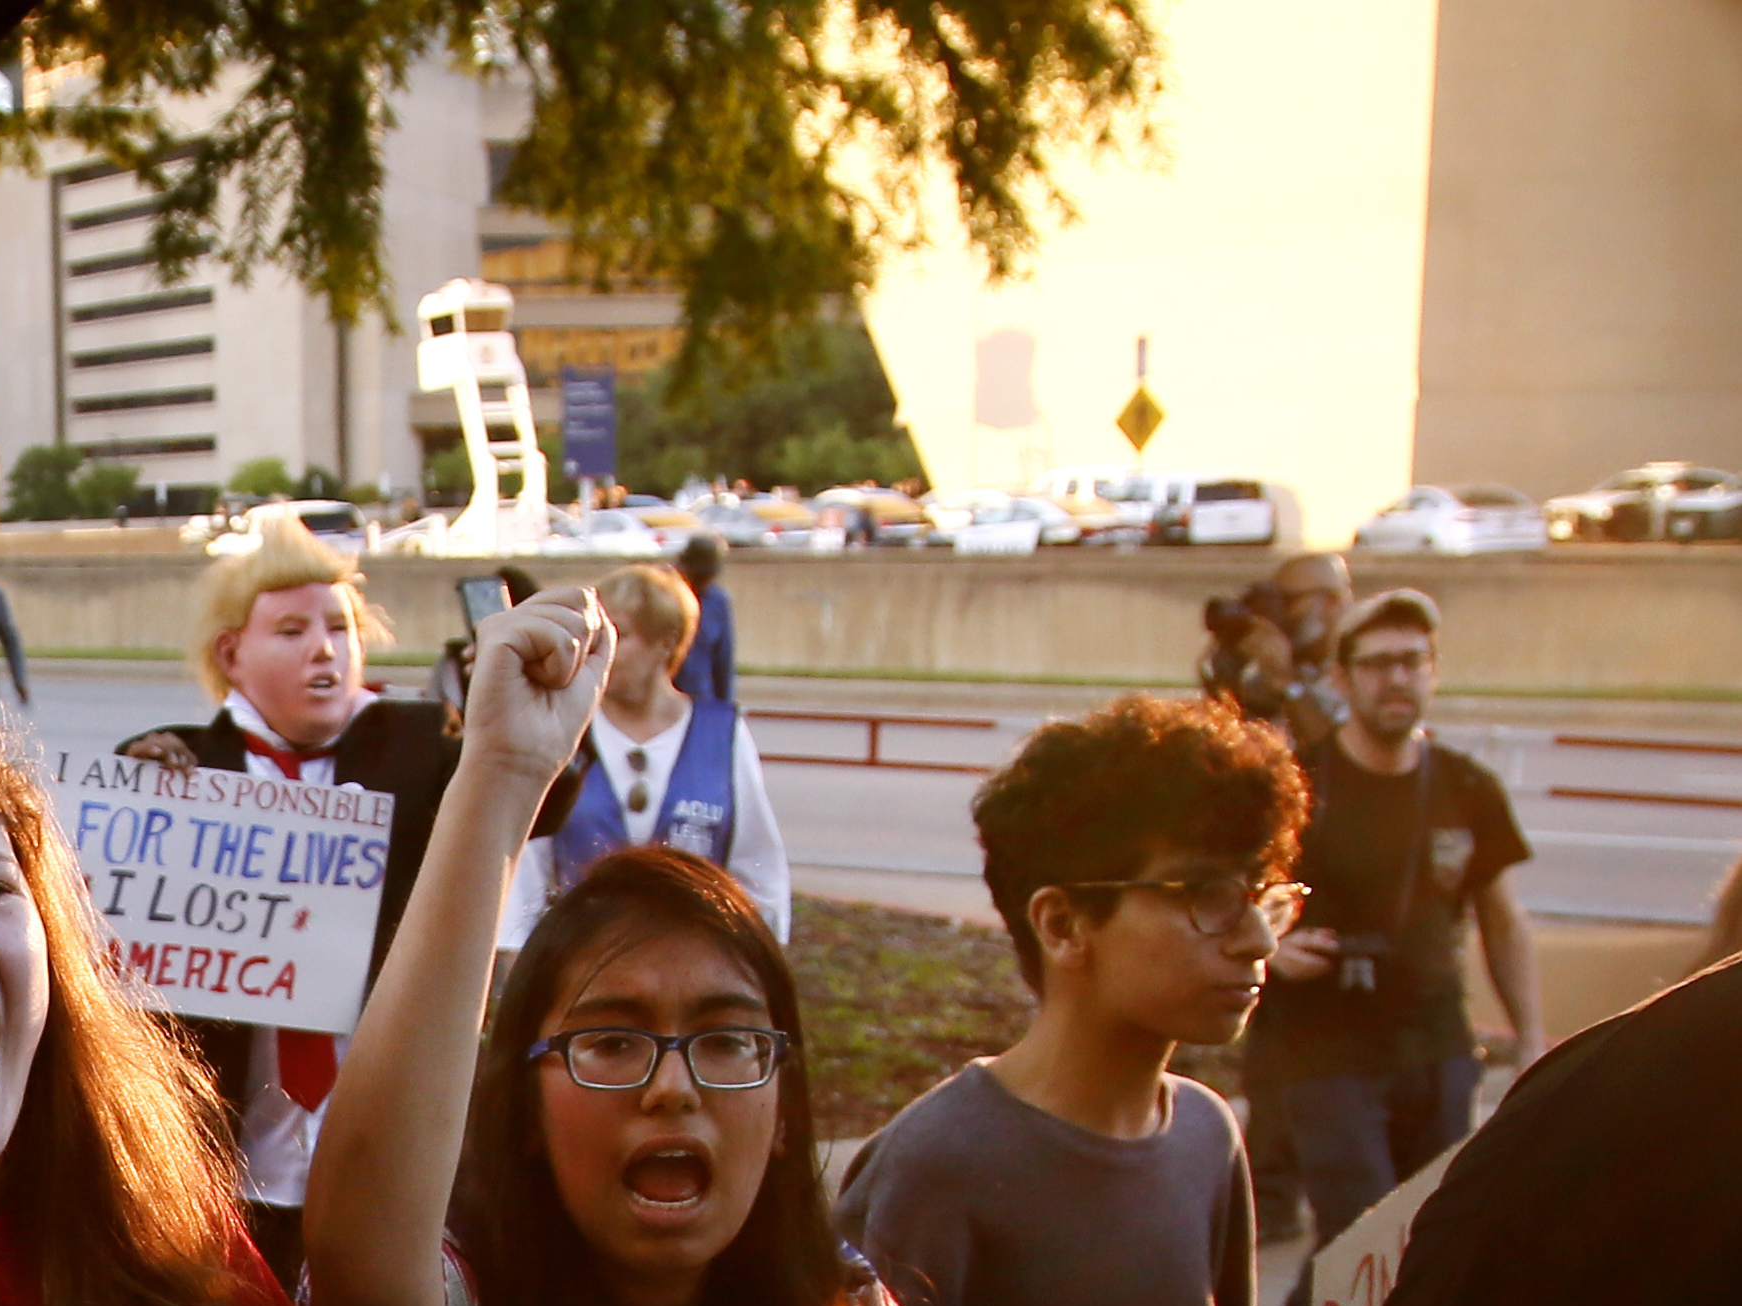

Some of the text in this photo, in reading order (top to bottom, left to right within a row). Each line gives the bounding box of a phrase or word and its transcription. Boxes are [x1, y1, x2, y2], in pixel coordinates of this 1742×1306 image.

[56, 751, 394, 829] I AM RESPONSIBLE
[75, 799, 391, 890] FOR THE LIVES
[104, 868, 137, 916] I
[103, 937, 299, 1001] AMERICA
